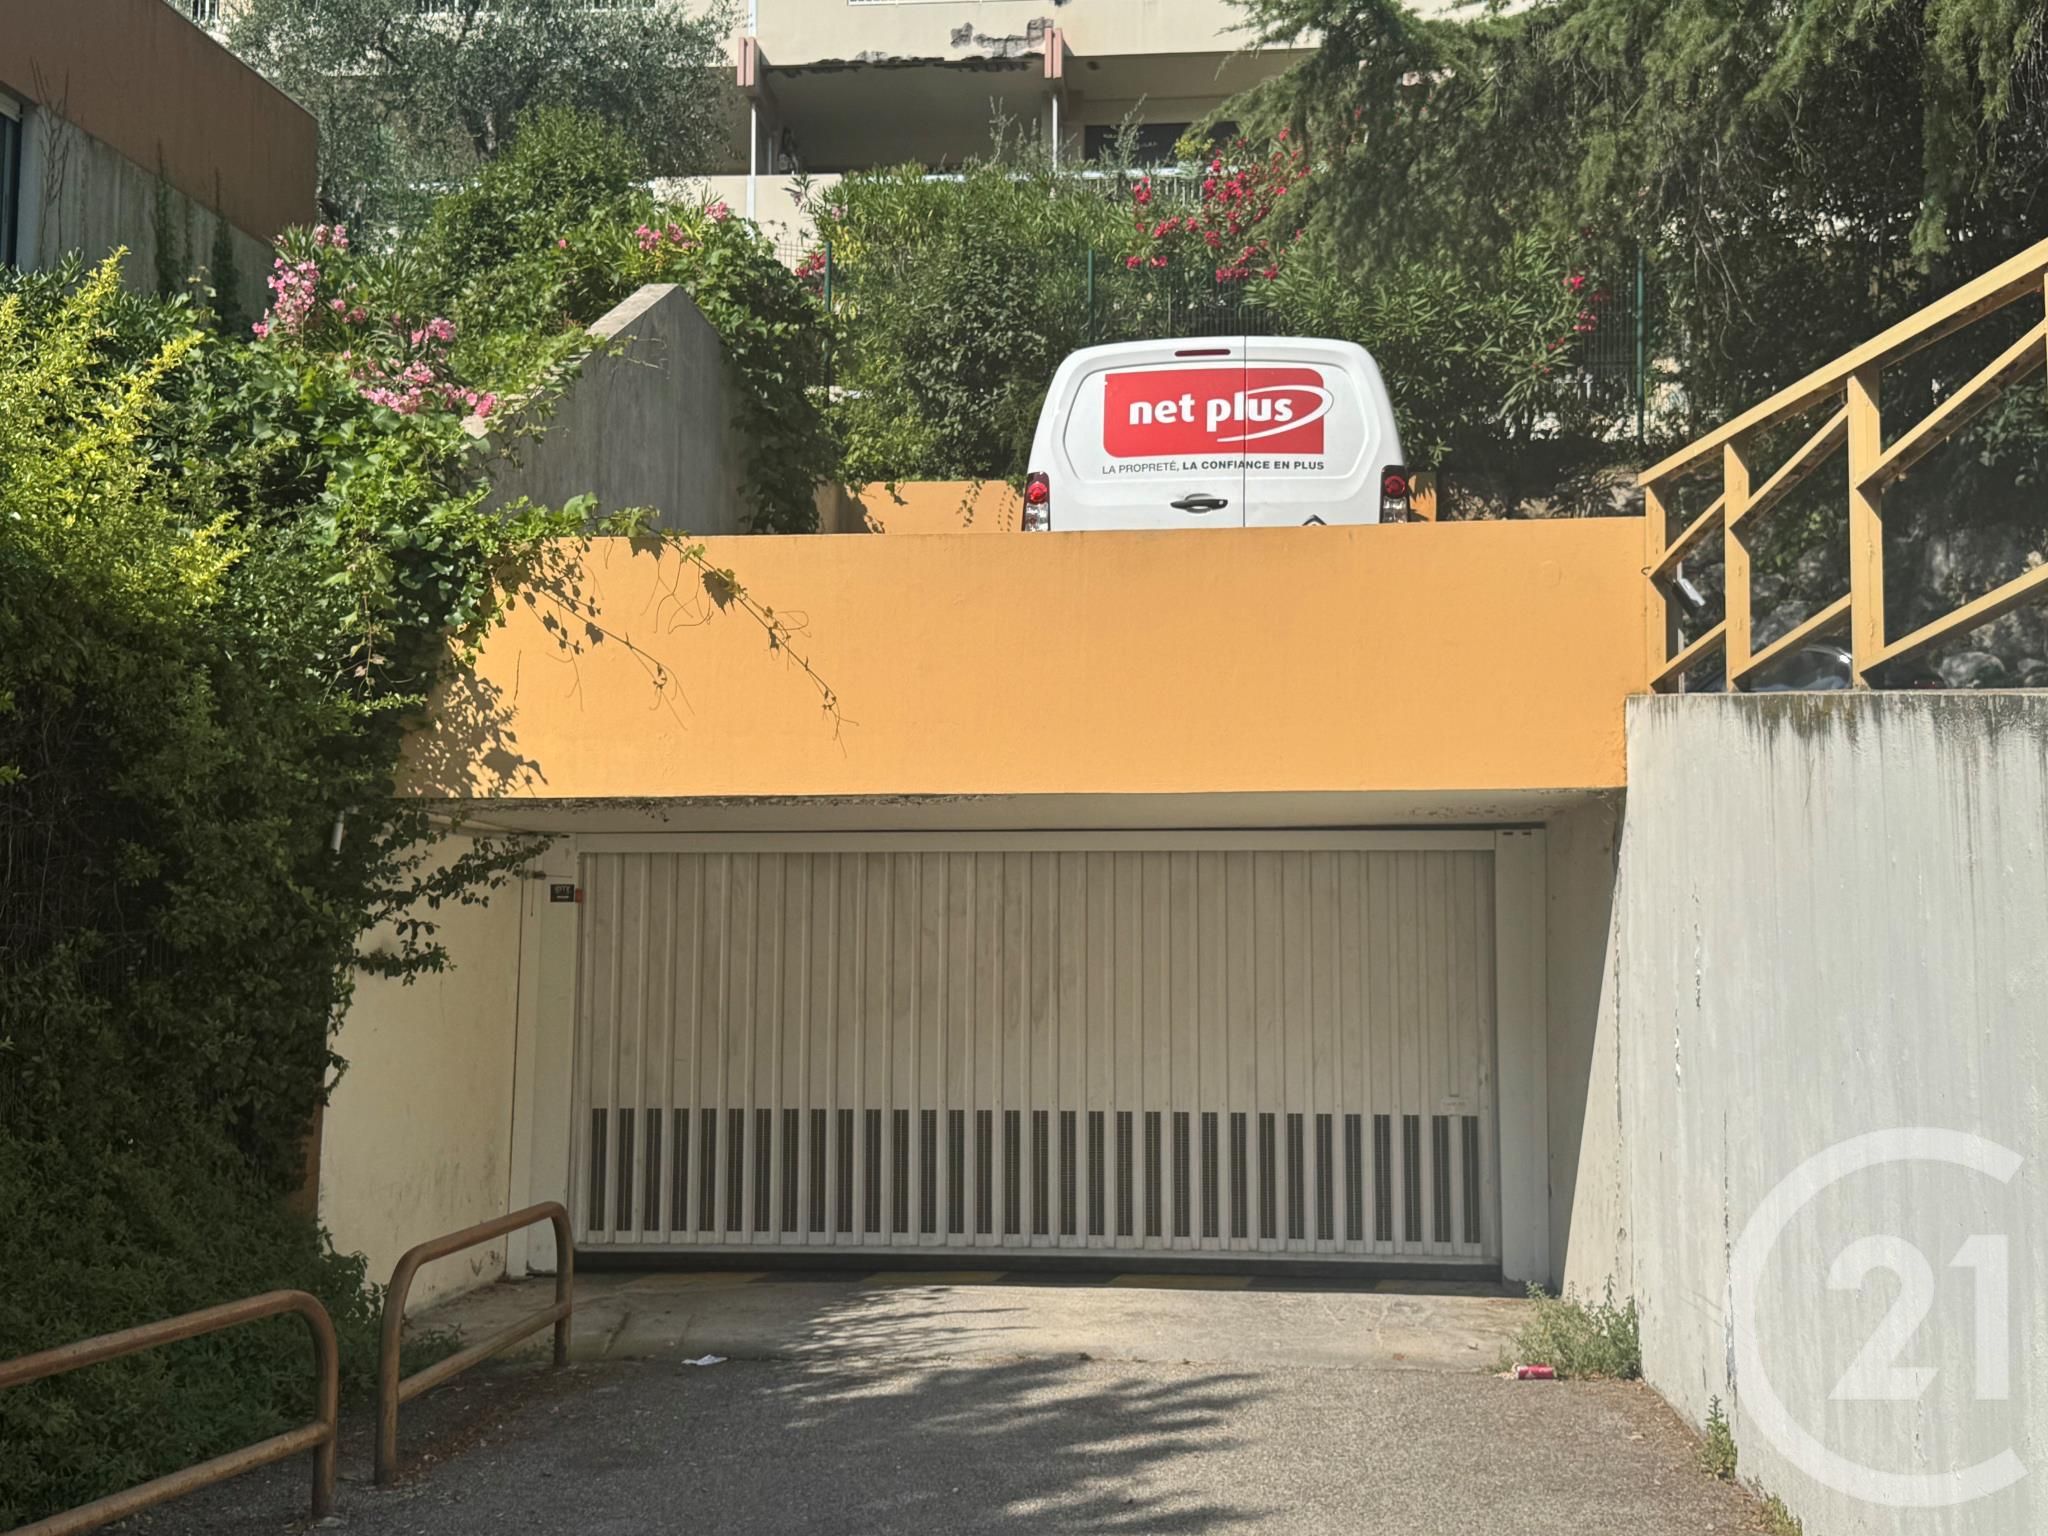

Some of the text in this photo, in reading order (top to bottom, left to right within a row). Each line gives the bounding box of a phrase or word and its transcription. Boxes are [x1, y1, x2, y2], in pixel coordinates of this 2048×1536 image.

[1129, 391, 1293, 432] net plus
[1102, 460, 1325, 475] LA PROPRETÉ, LA CONFIANCE EN PLUS
